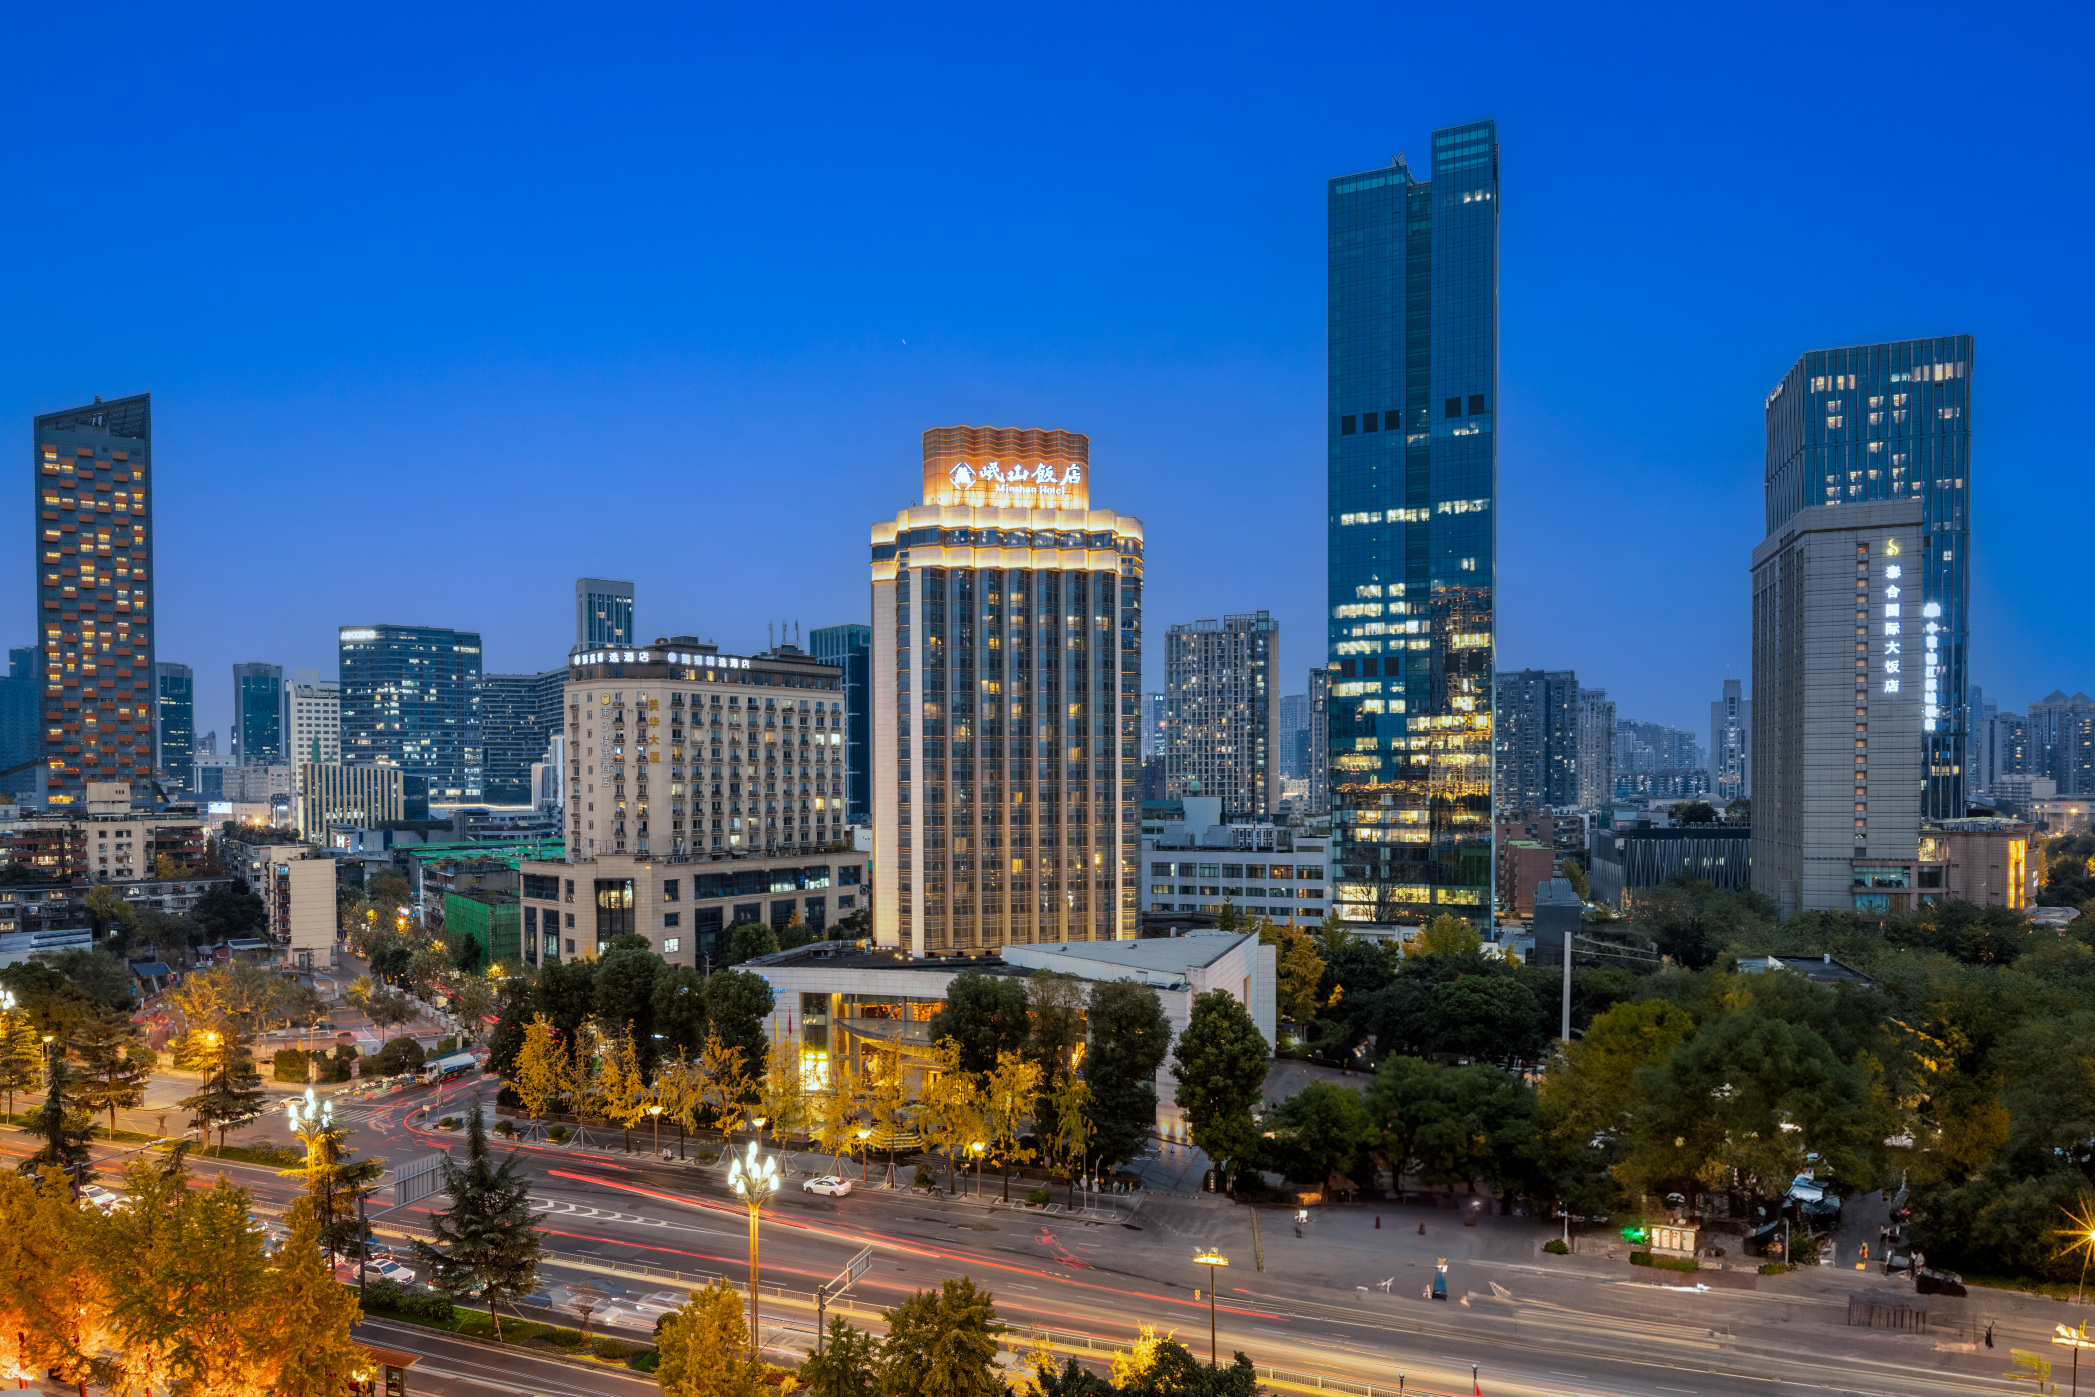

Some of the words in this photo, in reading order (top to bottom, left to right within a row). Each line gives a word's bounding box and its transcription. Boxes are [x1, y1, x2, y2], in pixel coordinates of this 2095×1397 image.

[979, 461, 1081, 486] 岷山飯店
[995, 484, 1037, 494] Minshan
[1039, 485, 1065, 495] Hotel
[649, 699, 660, 764] 美华大厦
